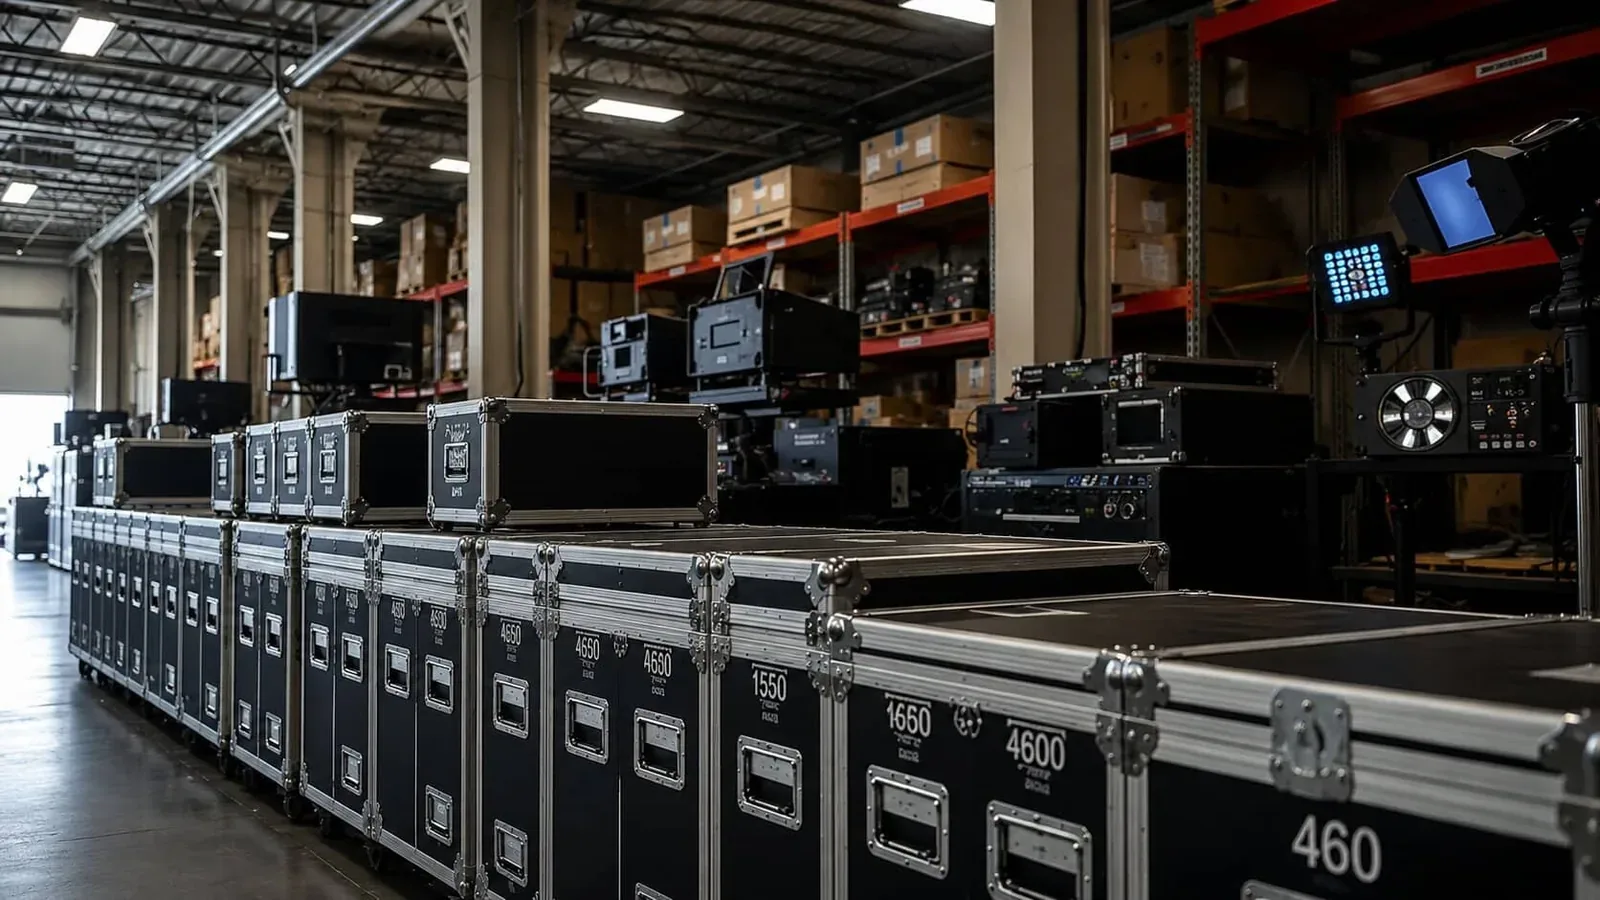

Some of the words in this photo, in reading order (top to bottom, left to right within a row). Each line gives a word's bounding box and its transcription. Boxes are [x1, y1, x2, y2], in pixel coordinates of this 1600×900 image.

[752, 670, 787, 701] 1550
[1006, 728, 1066, 771] 4600
[1291, 813, 1382, 884] 460
